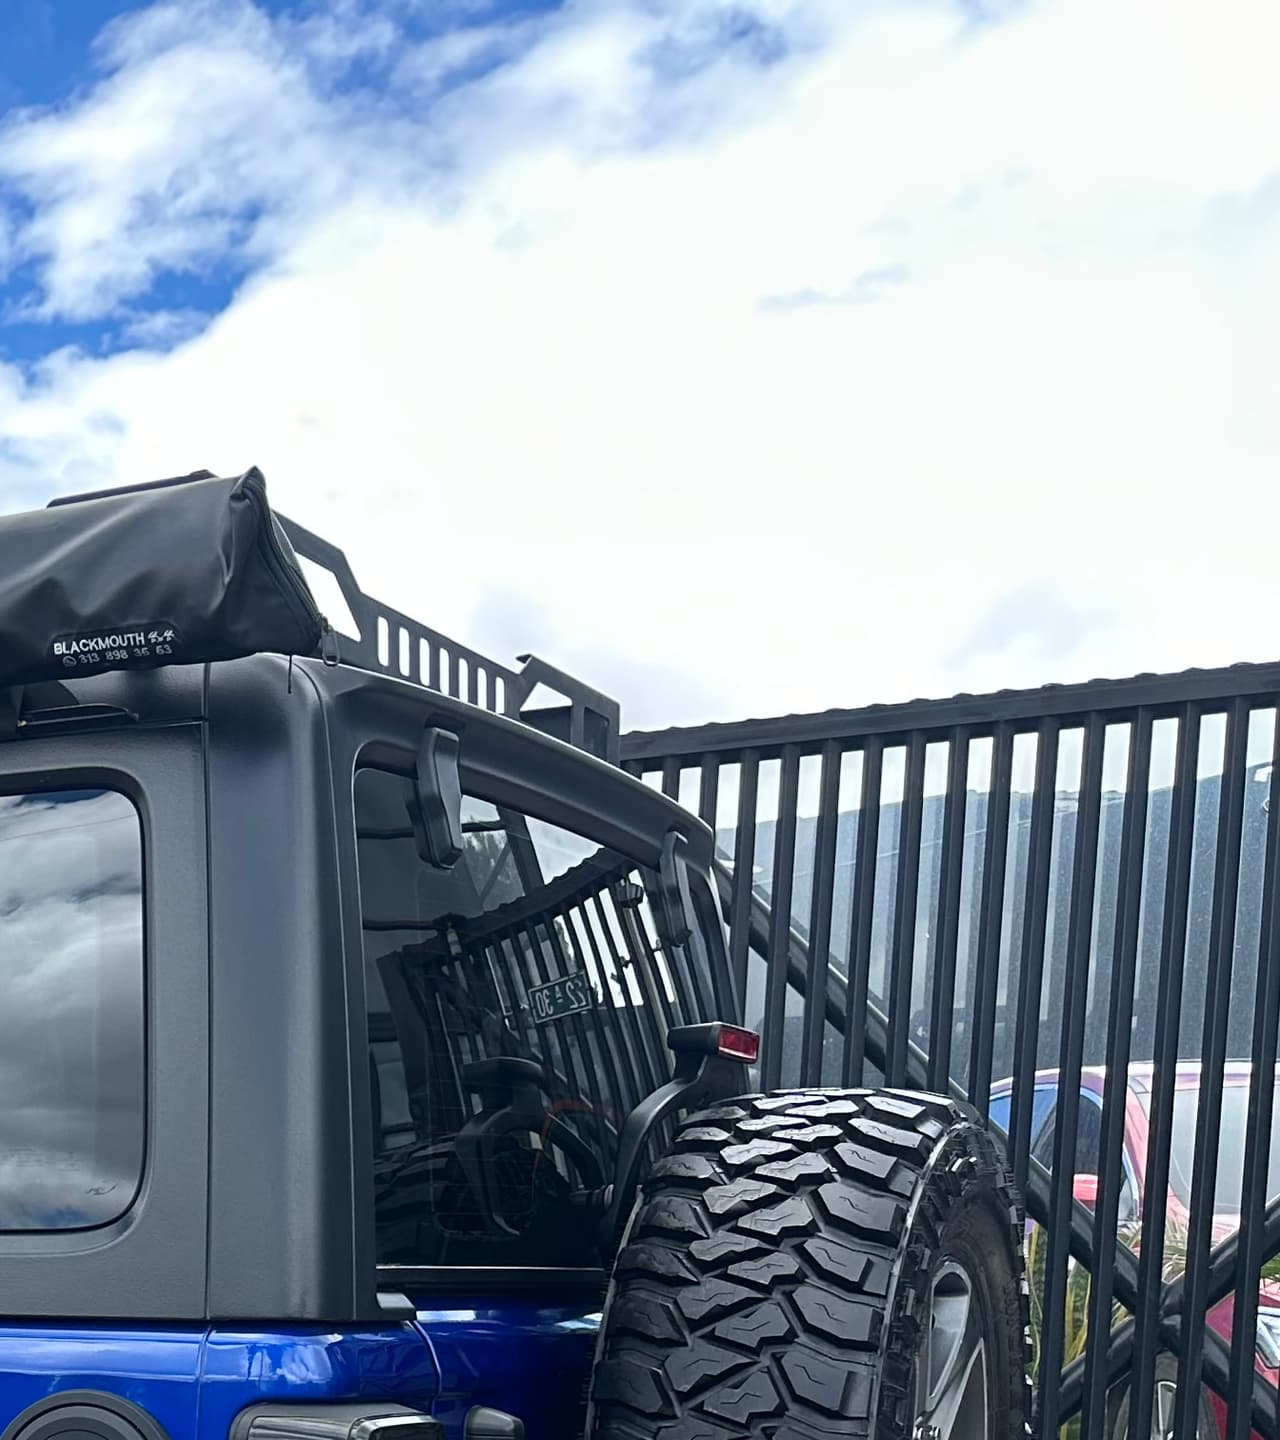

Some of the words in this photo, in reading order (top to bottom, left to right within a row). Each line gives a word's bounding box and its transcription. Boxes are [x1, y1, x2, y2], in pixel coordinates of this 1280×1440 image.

[53, 631, 146, 656] BLACKMOUTH
[78, 653, 101, 664] 313
[105, 649, 129, 661] 898
